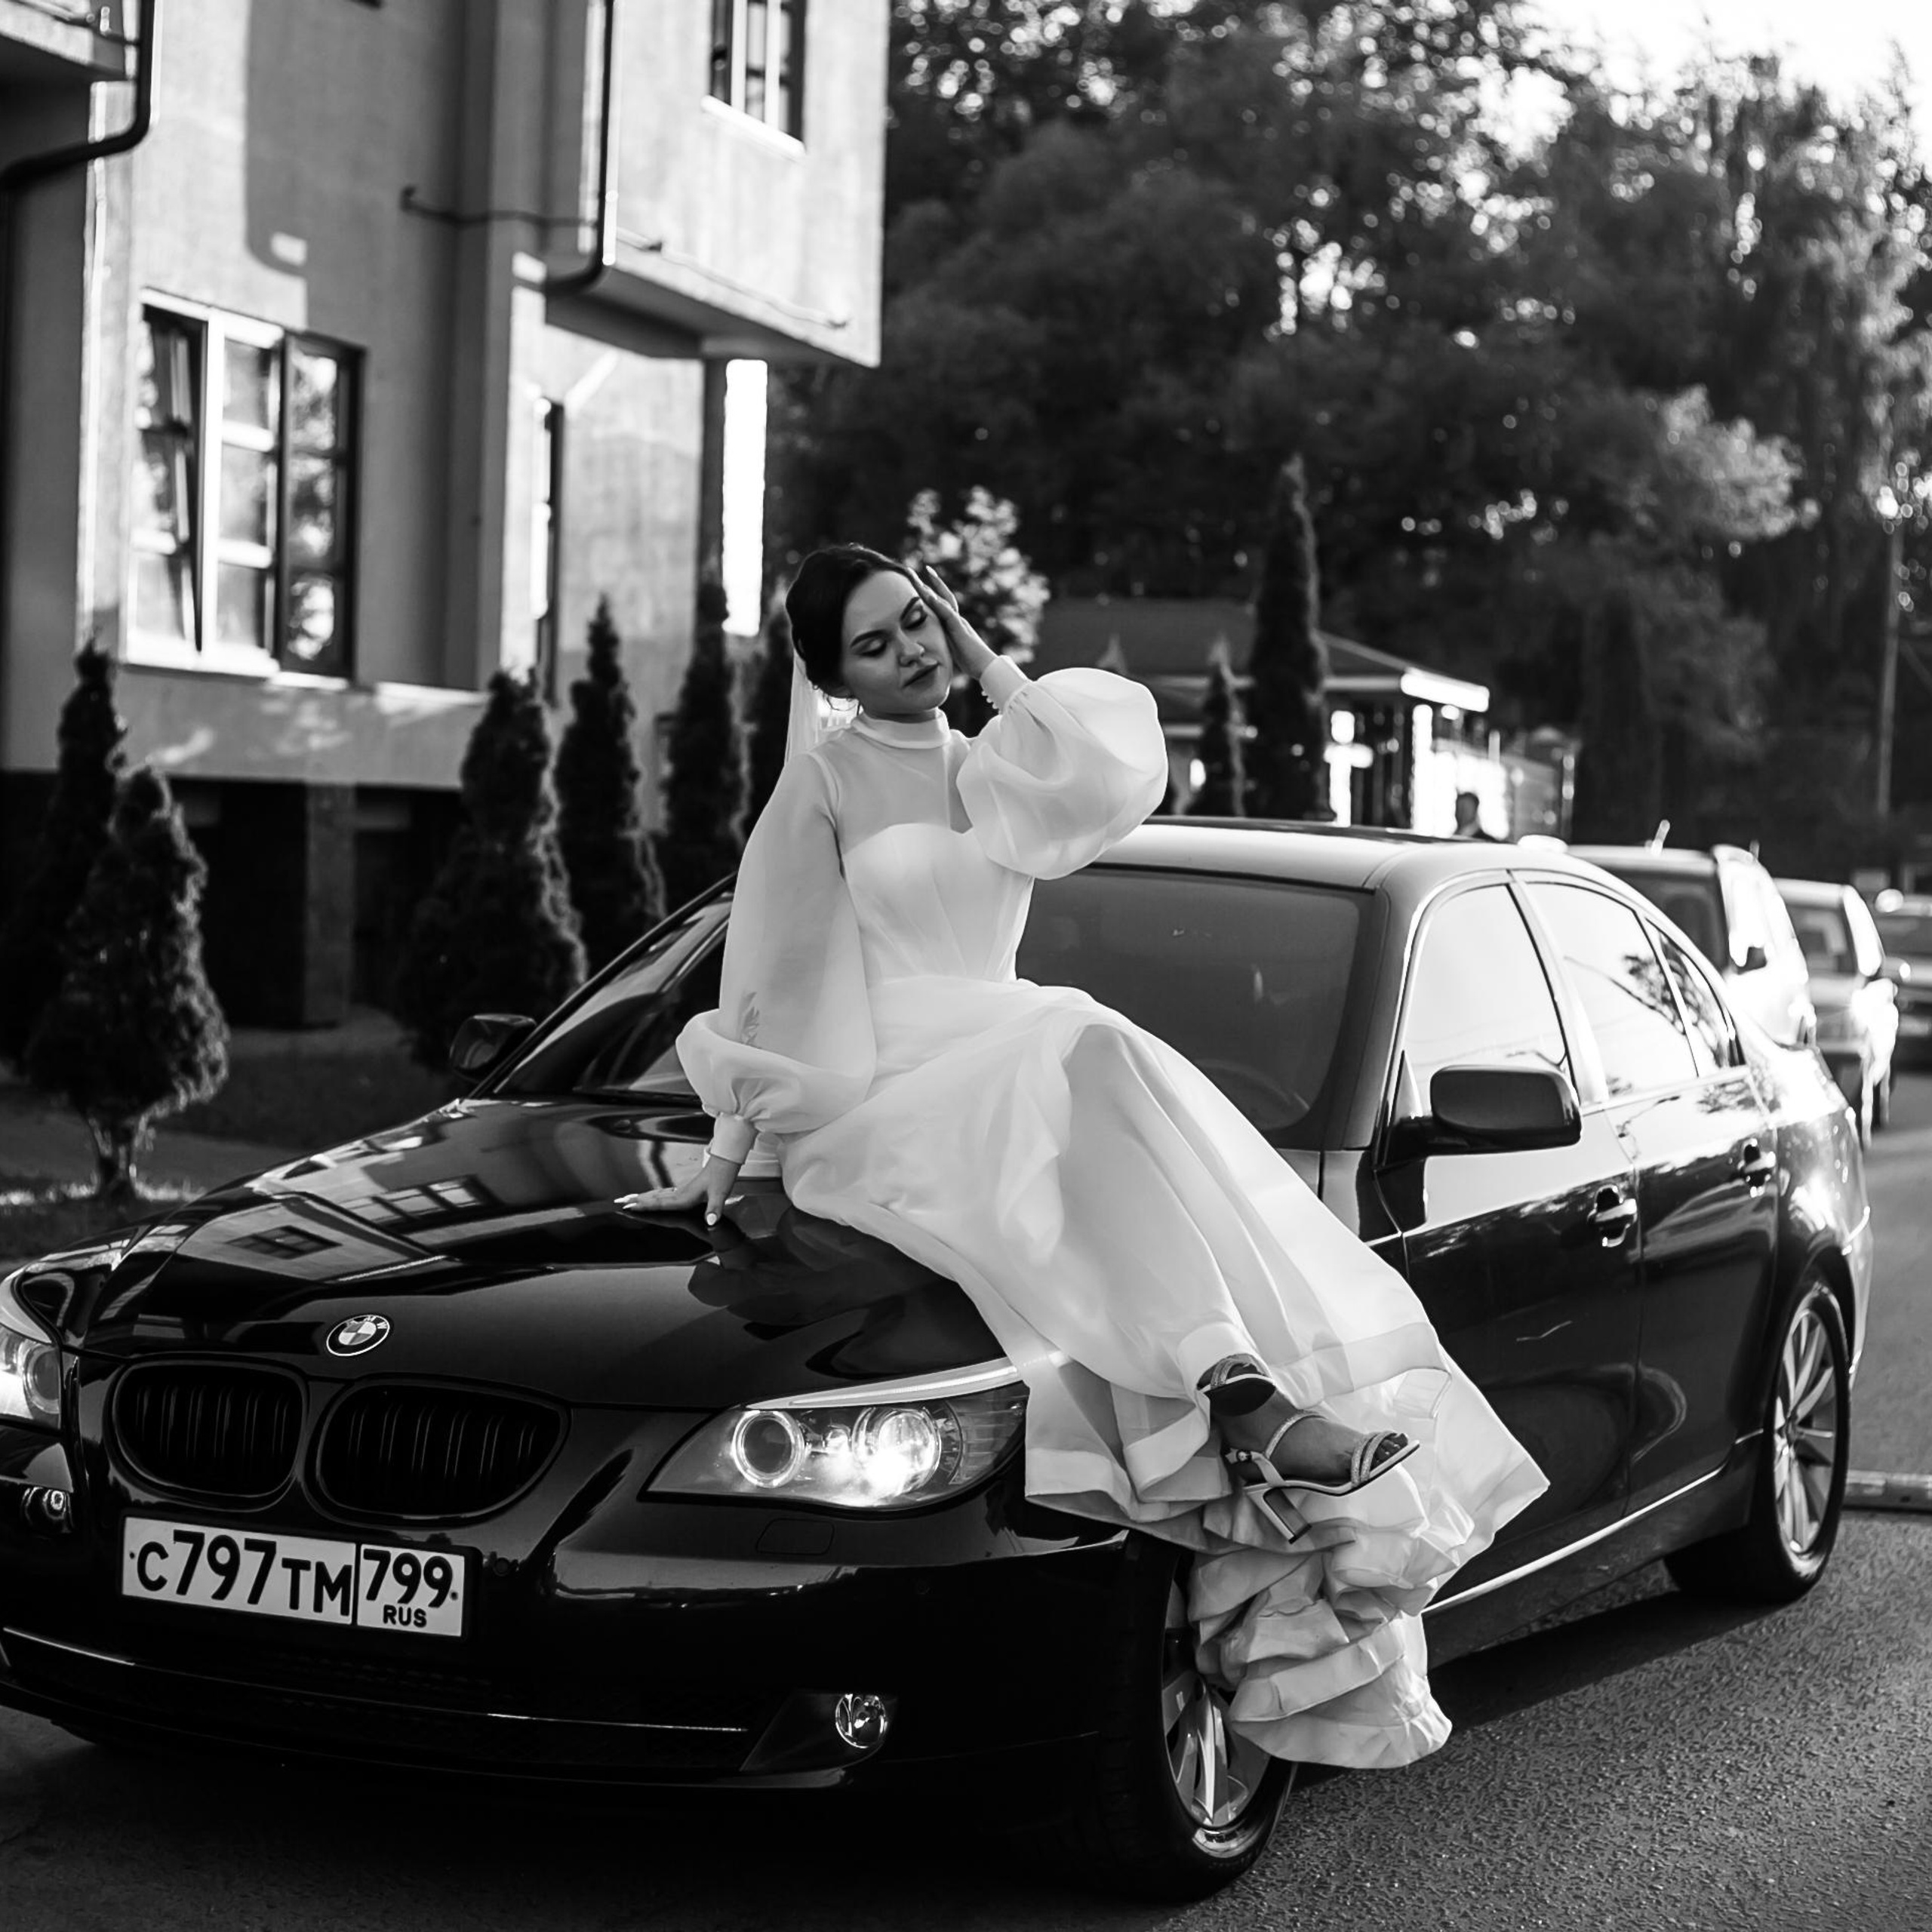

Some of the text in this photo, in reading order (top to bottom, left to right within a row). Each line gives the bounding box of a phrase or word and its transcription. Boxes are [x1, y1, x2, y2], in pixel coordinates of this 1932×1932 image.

[137, 1530, 453, 1617] C797TM 799
[383, 1604, 427, 1629] RUS
